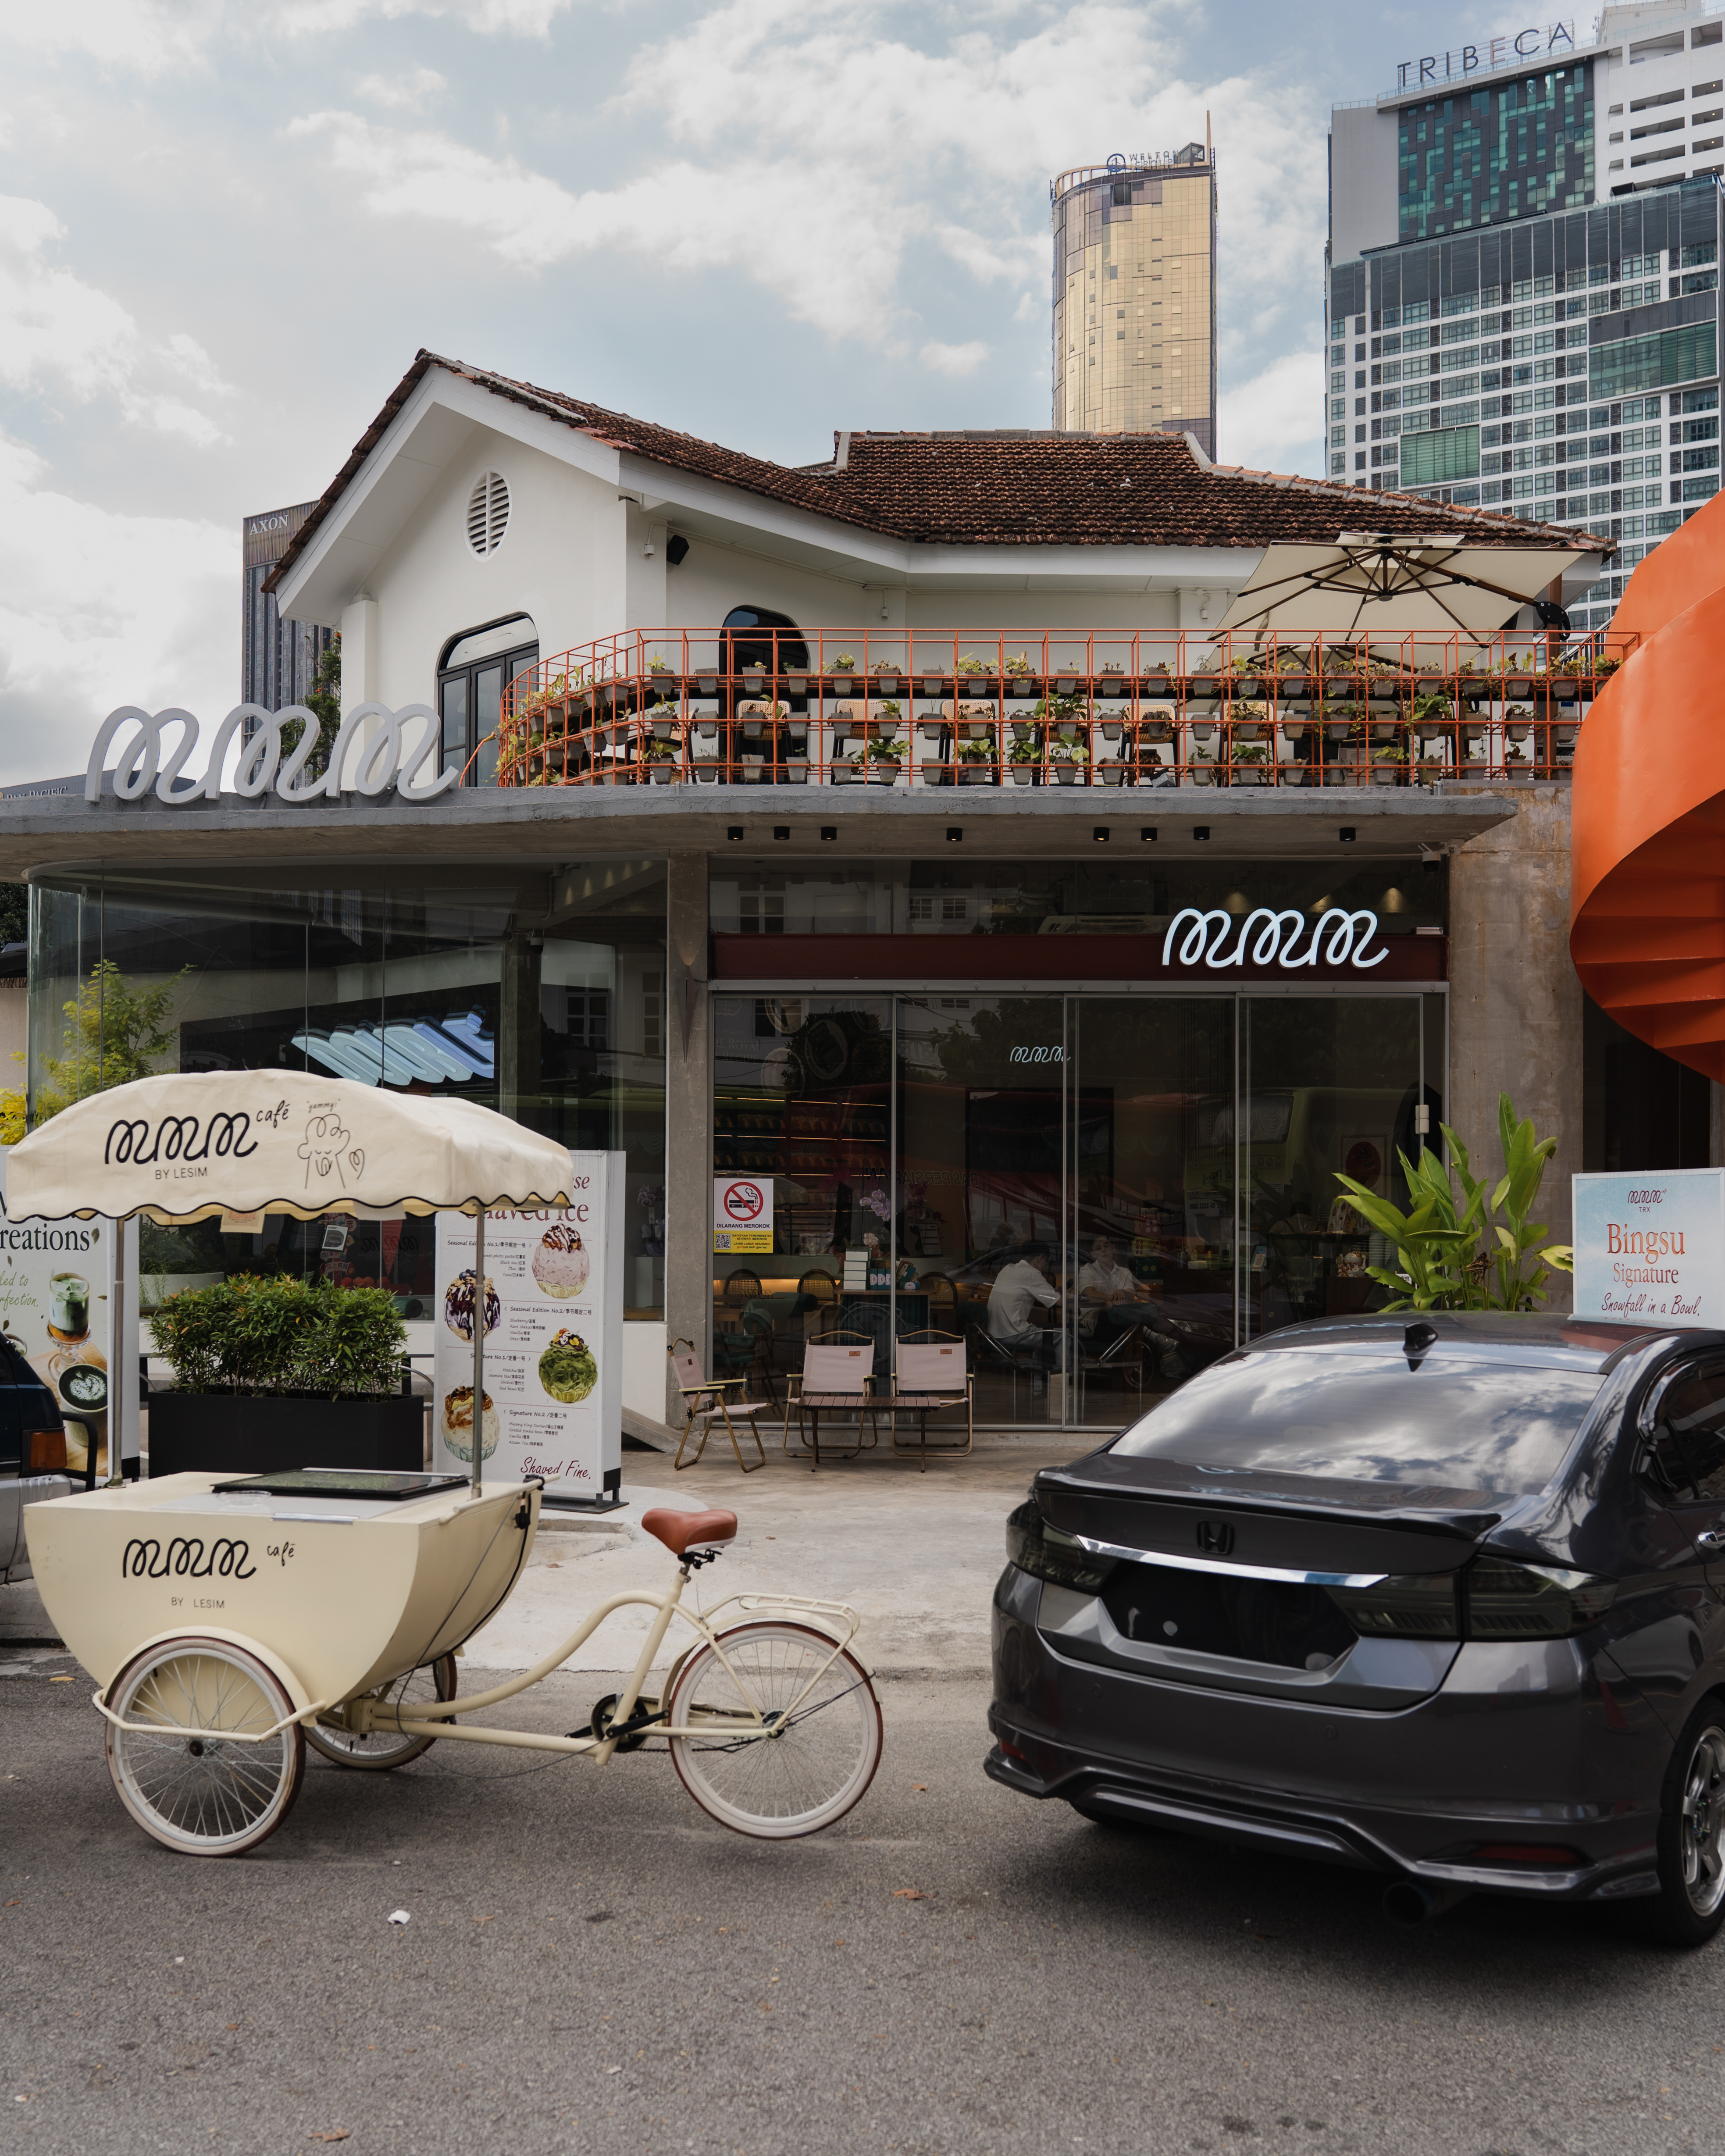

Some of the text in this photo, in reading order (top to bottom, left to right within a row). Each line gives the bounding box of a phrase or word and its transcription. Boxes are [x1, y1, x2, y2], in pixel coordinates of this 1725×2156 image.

[1397, 21, 1573, 87] TRIBECA
[249, 514, 289, 536] AXON
[1162, 908, 1390, 969] mmm
[256, 1100, 290, 1129] café
[155, 1166, 208, 1180] BY LESIM
[1607, 1223, 1685, 1264] Bingsu
[19, 1274, 29, 1286] to
[1613, 1262, 1679, 1288] Signature
[1601, 1292, 1702, 1318] Snowfall in a Bowl.
[520, 1457, 591, 1479] Shaved Fine.
[171, 1597, 225, 1609] BY LESIM
